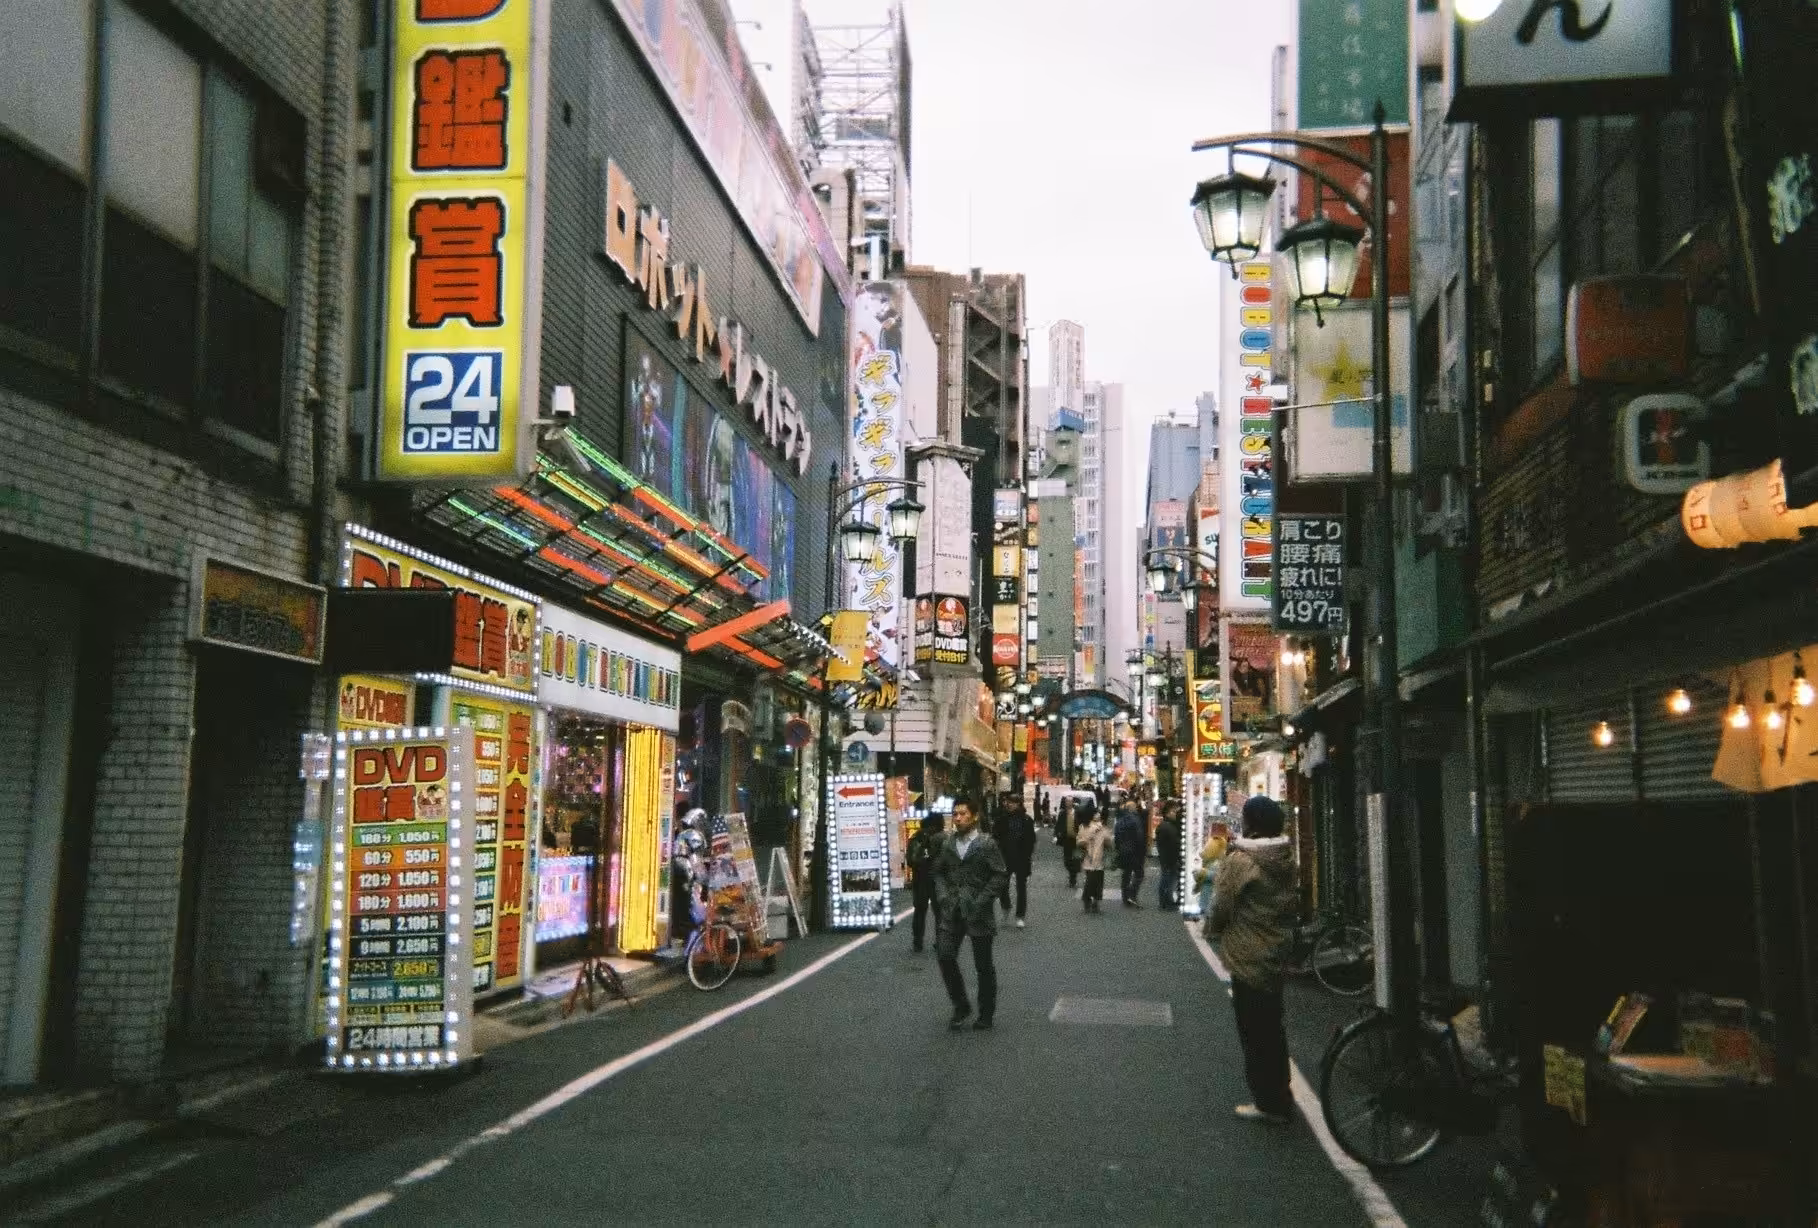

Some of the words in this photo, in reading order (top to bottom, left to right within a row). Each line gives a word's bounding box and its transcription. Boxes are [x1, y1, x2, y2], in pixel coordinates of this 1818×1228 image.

[408, 355, 498, 424] 24
[407, 426, 496, 450] OPEN
[1280, 520, 1341, 540] 肩こり
[1280, 543, 1341, 564] 腰痛
[1281, 600, 1342, 622] 497円
[541, 626, 598, 689] ROBOT
[354, 745, 447, 785] DVD
